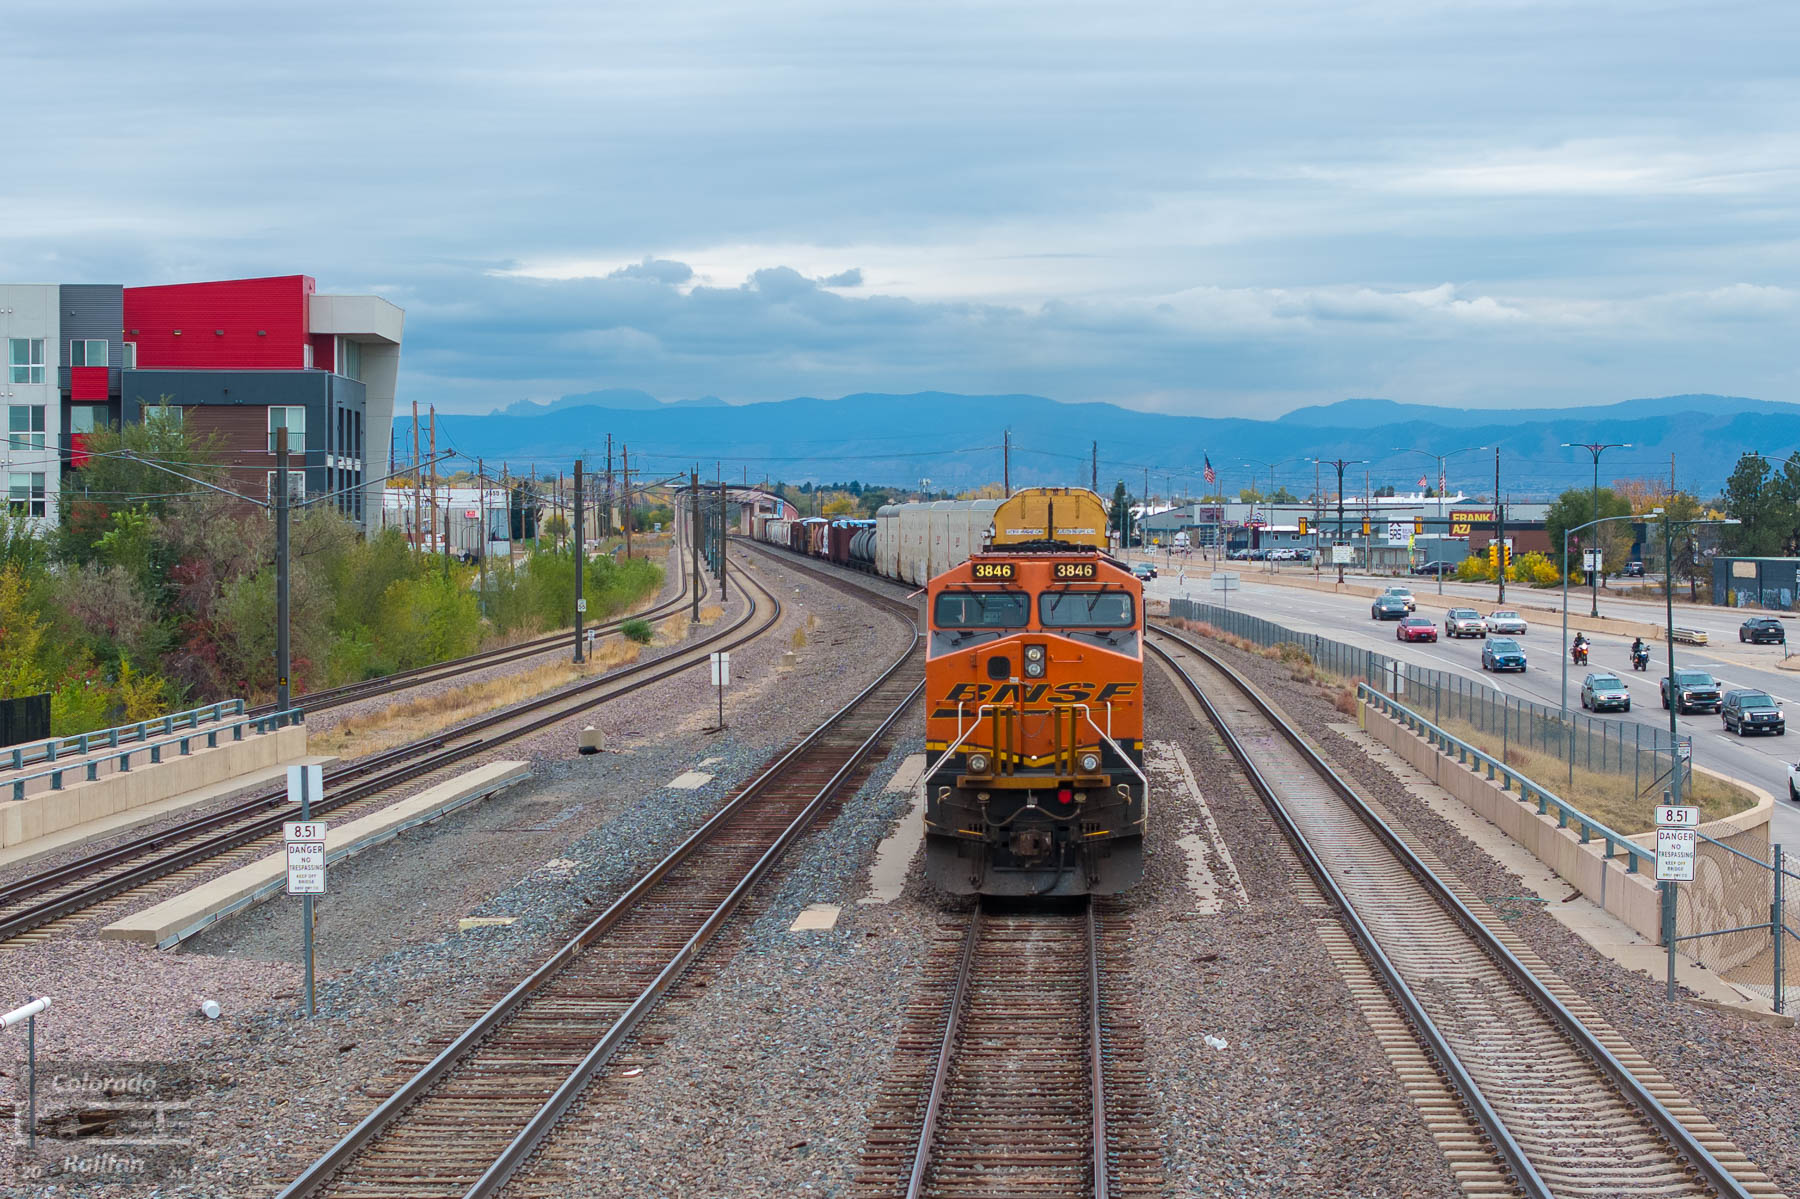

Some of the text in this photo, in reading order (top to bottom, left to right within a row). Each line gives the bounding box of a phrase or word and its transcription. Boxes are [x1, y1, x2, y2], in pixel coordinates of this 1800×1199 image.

[1452, 513, 1491, 521] FRANK
[976, 564, 1011, 577] 3846
[1057, 564, 1093, 577] 3846
[943, 682, 1140, 704] BNSF
[1666, 809, 1688, 822] 8.51
[294, 825, 316, 838] 8.51
[1659, 832, 1694, 841] DANGER
[289, 845, 323, 854] DANGER
[1659, 851, 1694, 859] TRESPASSING
